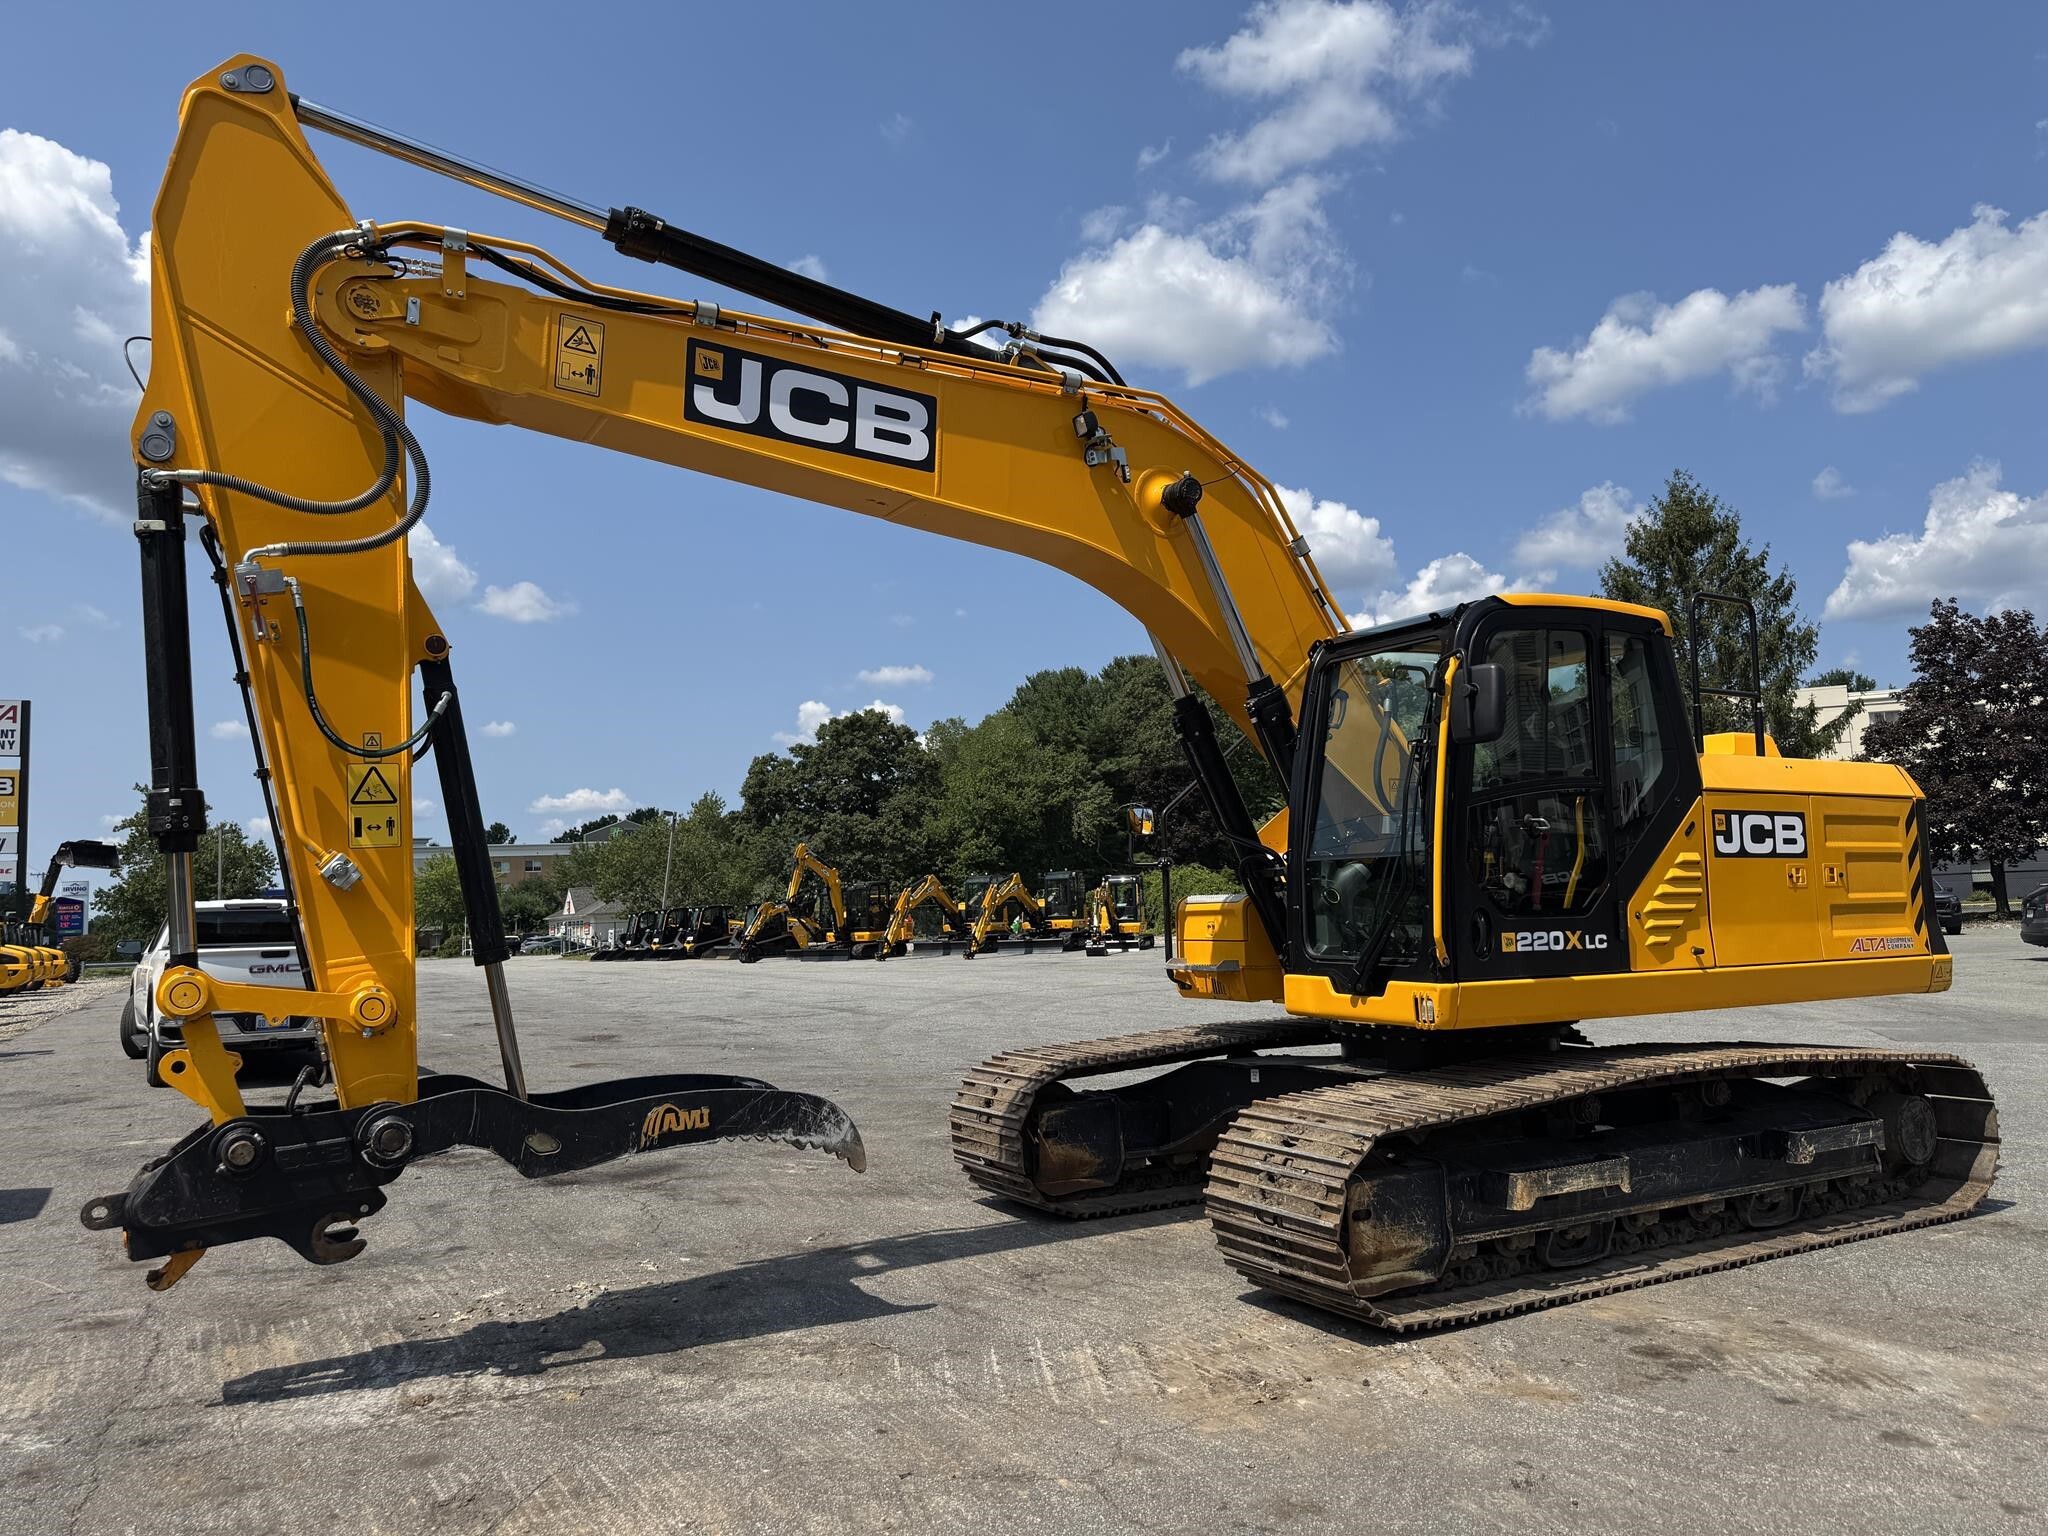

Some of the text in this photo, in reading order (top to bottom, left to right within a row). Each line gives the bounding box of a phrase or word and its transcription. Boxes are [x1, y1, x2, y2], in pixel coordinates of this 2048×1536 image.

[693, 358, 930, 462] JCB
[1715, 814, 1805, 854] JCB
[1850, 937, 1886, 952] ALTA
[249, 964, 301, 973] GMC
